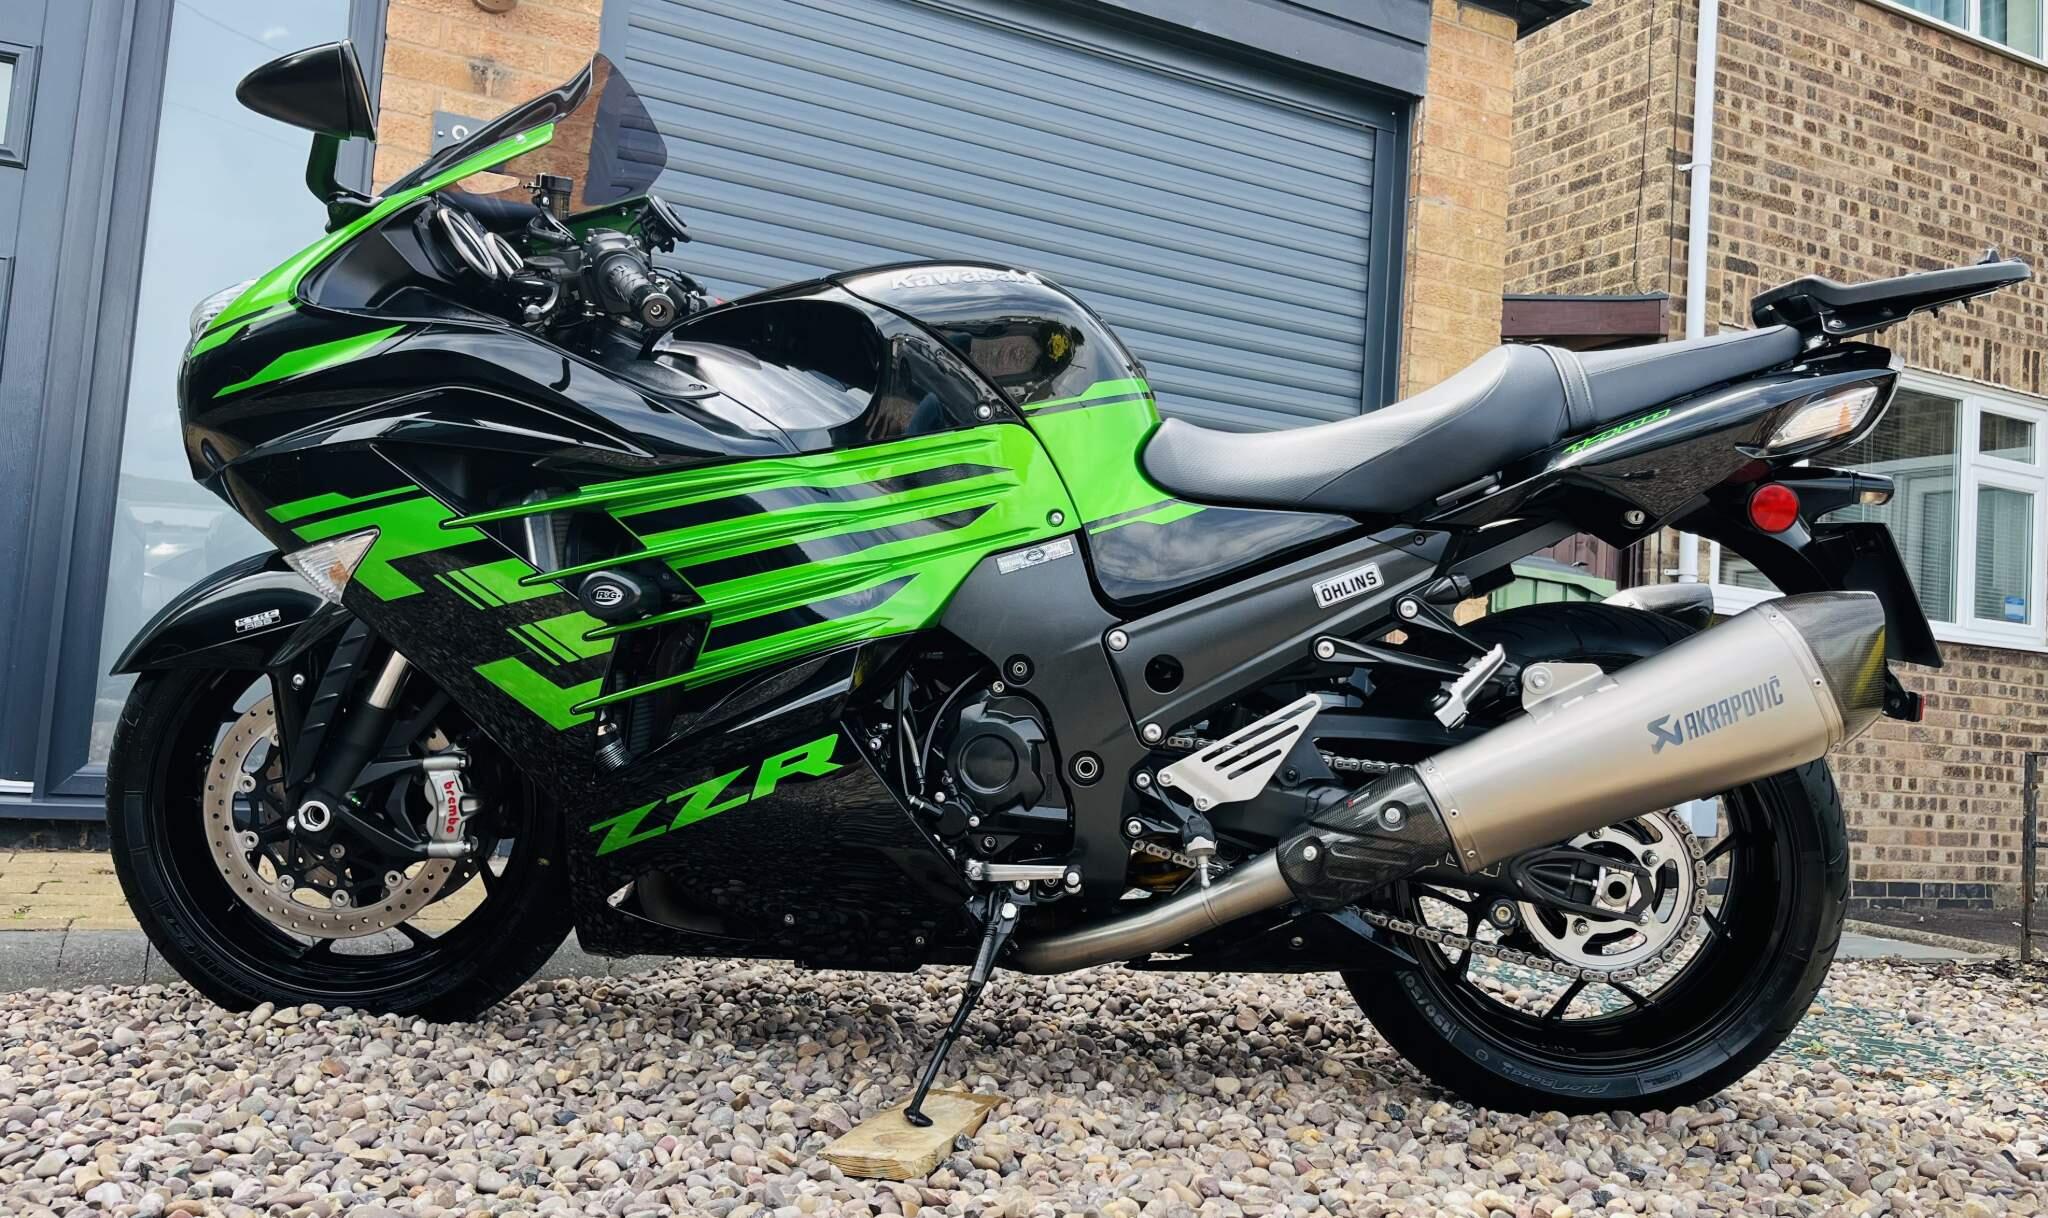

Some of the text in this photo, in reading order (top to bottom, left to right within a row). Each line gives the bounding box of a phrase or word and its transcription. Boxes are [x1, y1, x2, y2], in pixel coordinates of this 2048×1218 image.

[1320, 571, 1377, 602] ÖHLINS
[443, 780, 460, 833] brembo
[589, 733, 844, 857] ZZR
